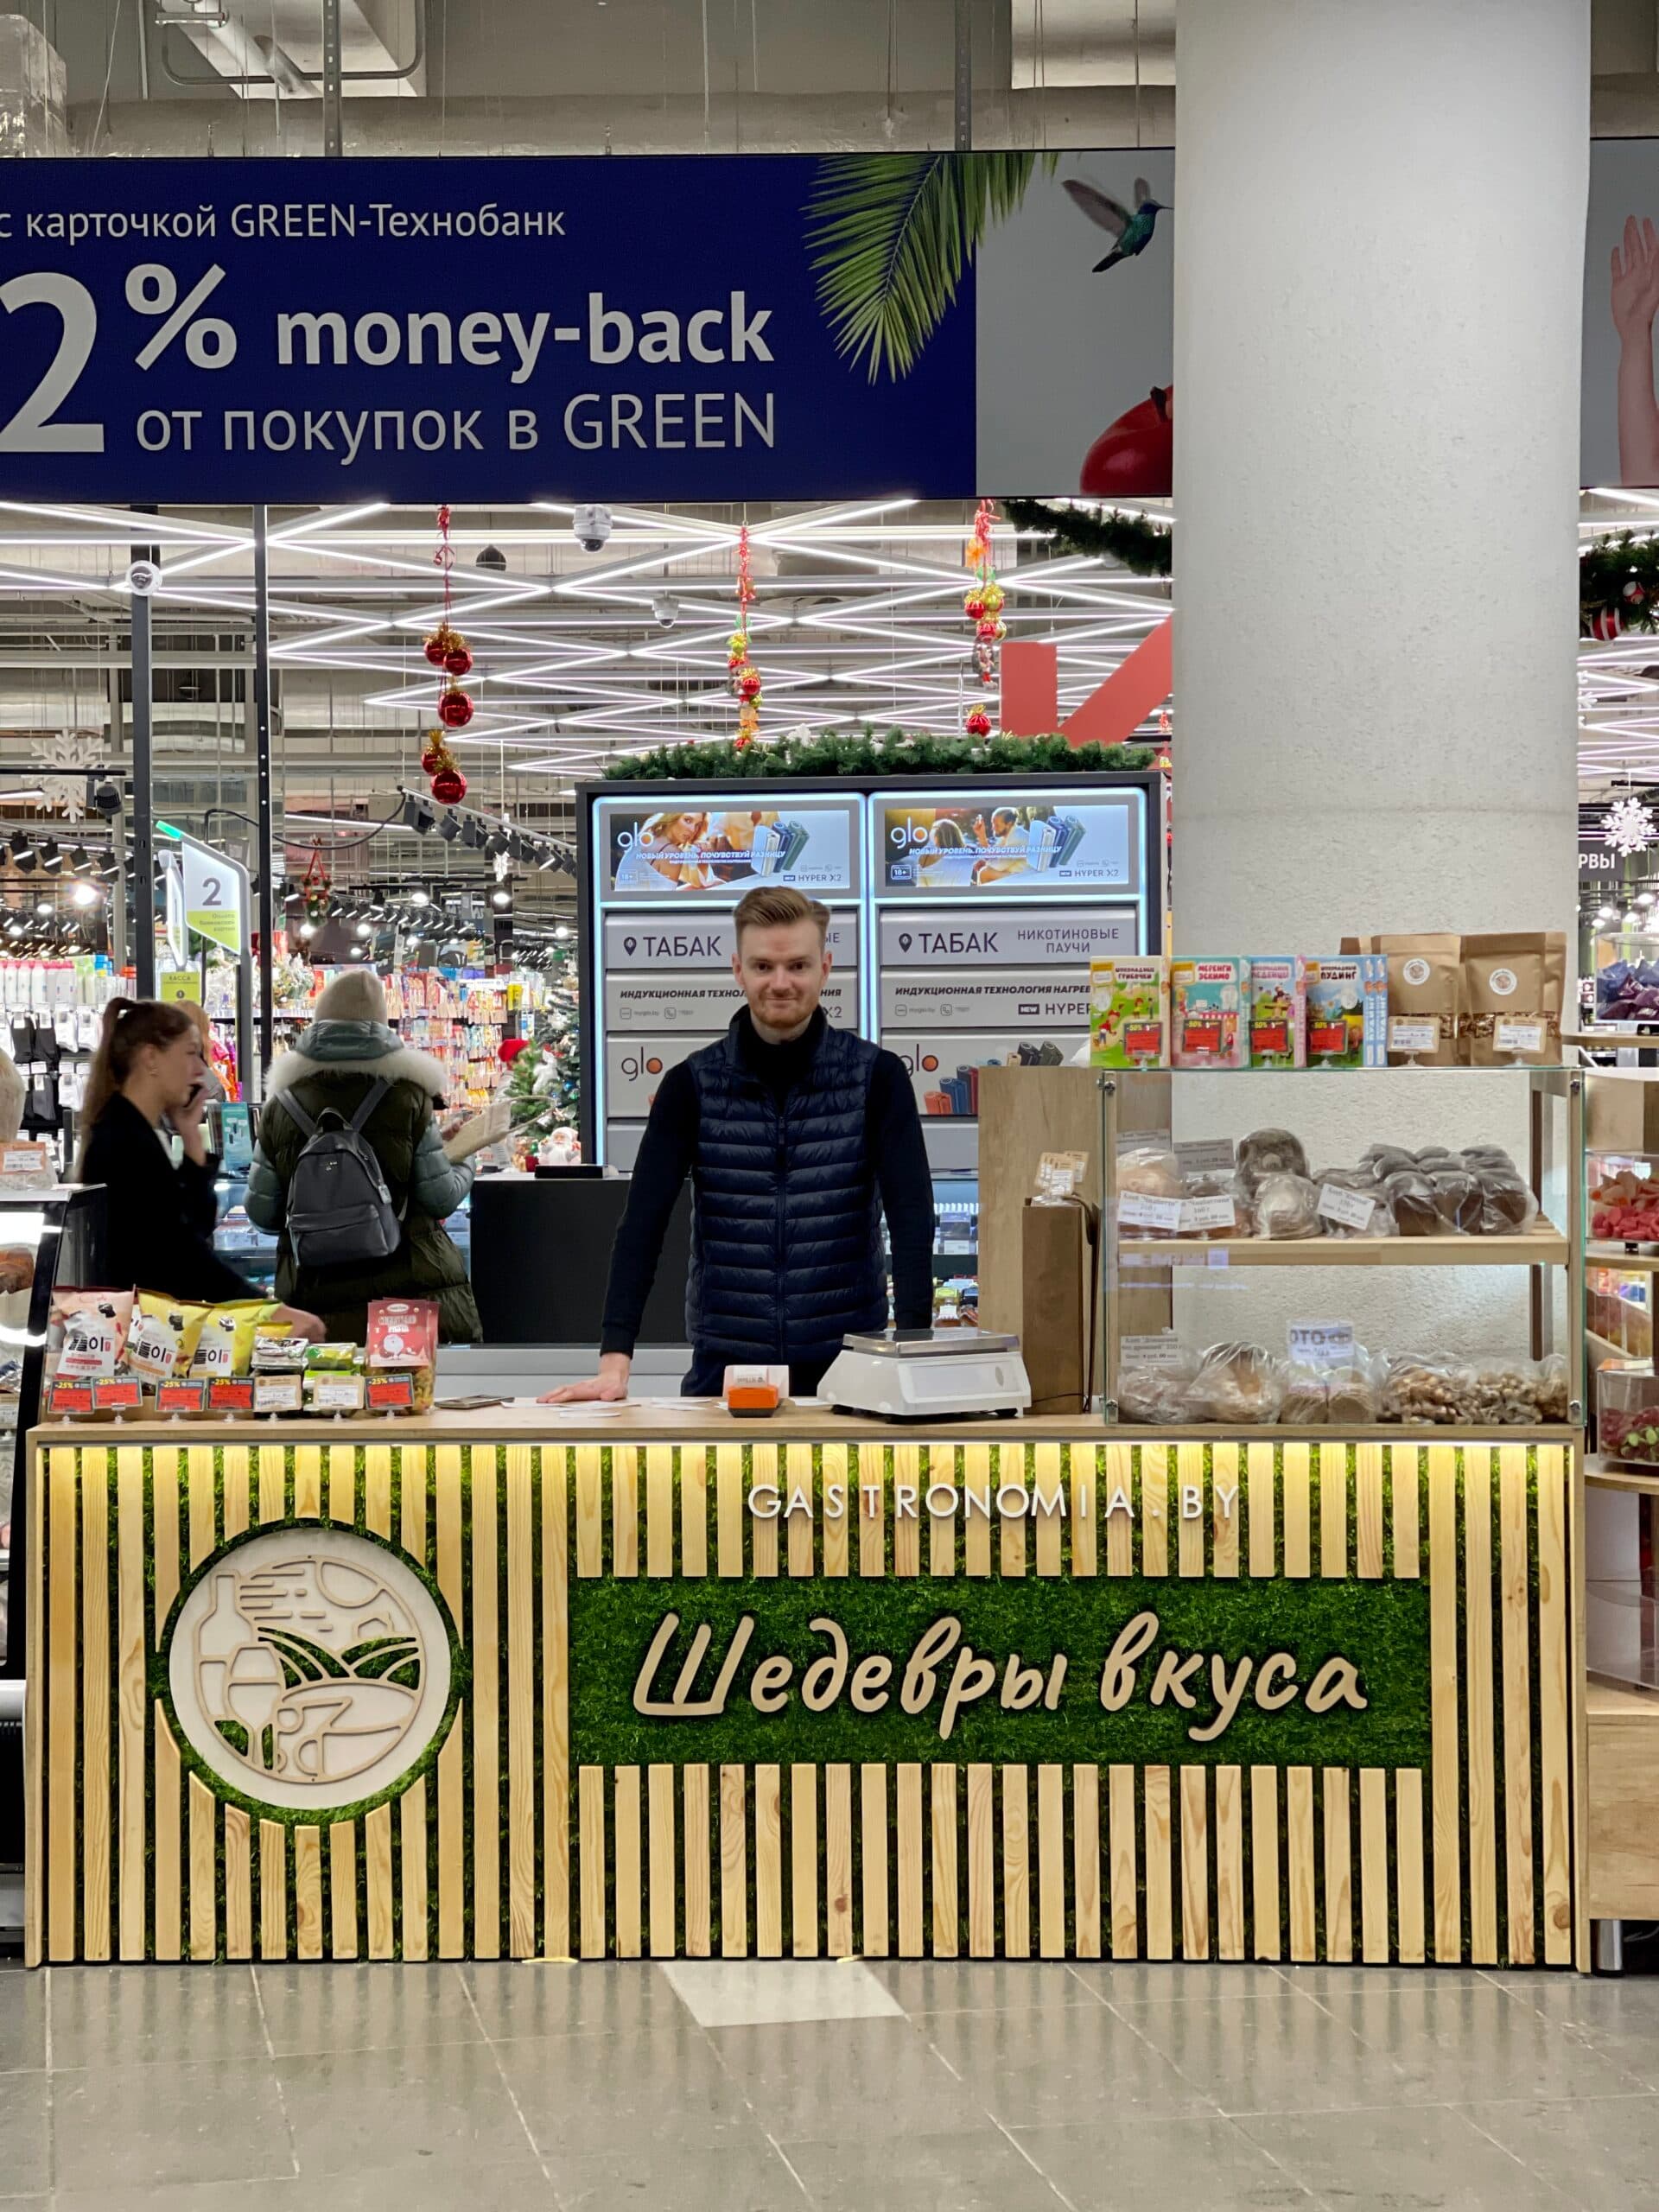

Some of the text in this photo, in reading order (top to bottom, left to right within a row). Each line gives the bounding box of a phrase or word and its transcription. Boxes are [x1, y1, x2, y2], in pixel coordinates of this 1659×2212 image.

[0, 204, 567, 246] с карточкой GREEN-Технобанк
[276, 291, 776, 385] money-back
[137, 393, 777, 466] от покупок в GREEN
[616, 821, 655, 852] glo
[890, 816, 929, 850] glo
[1074, 869, 1103, 878] HYPER
[201, 877, 223, 906] 2
[918, 932, 999, 953] ТАБАК
[1018, 928, 1120, 940] НИКОТИНОВЫЕ
[643, 936, 722, 957] ТАБАК
[1046, 943, 1090, 953] ПАУЧИ
[1320, 970, 1357, 980] ПУДИНГ
[620, 989, 706, 999] ИНДУКЦИОННАЯ
[895, 987, 982, 996] ИНДУКЦИОННАЯ
[984, 985, 1052, 995] ТЕХНОЛОГИЯ
[1020, 1004, 1039, 1014] NEW
[621, 1046, 664, 1081] glo
[161, 1380, 181, 1389] -25%
[368, 1377, 388, 1386] -25%
[631, 1610, 1369, 1742] Шедевры вкуса
